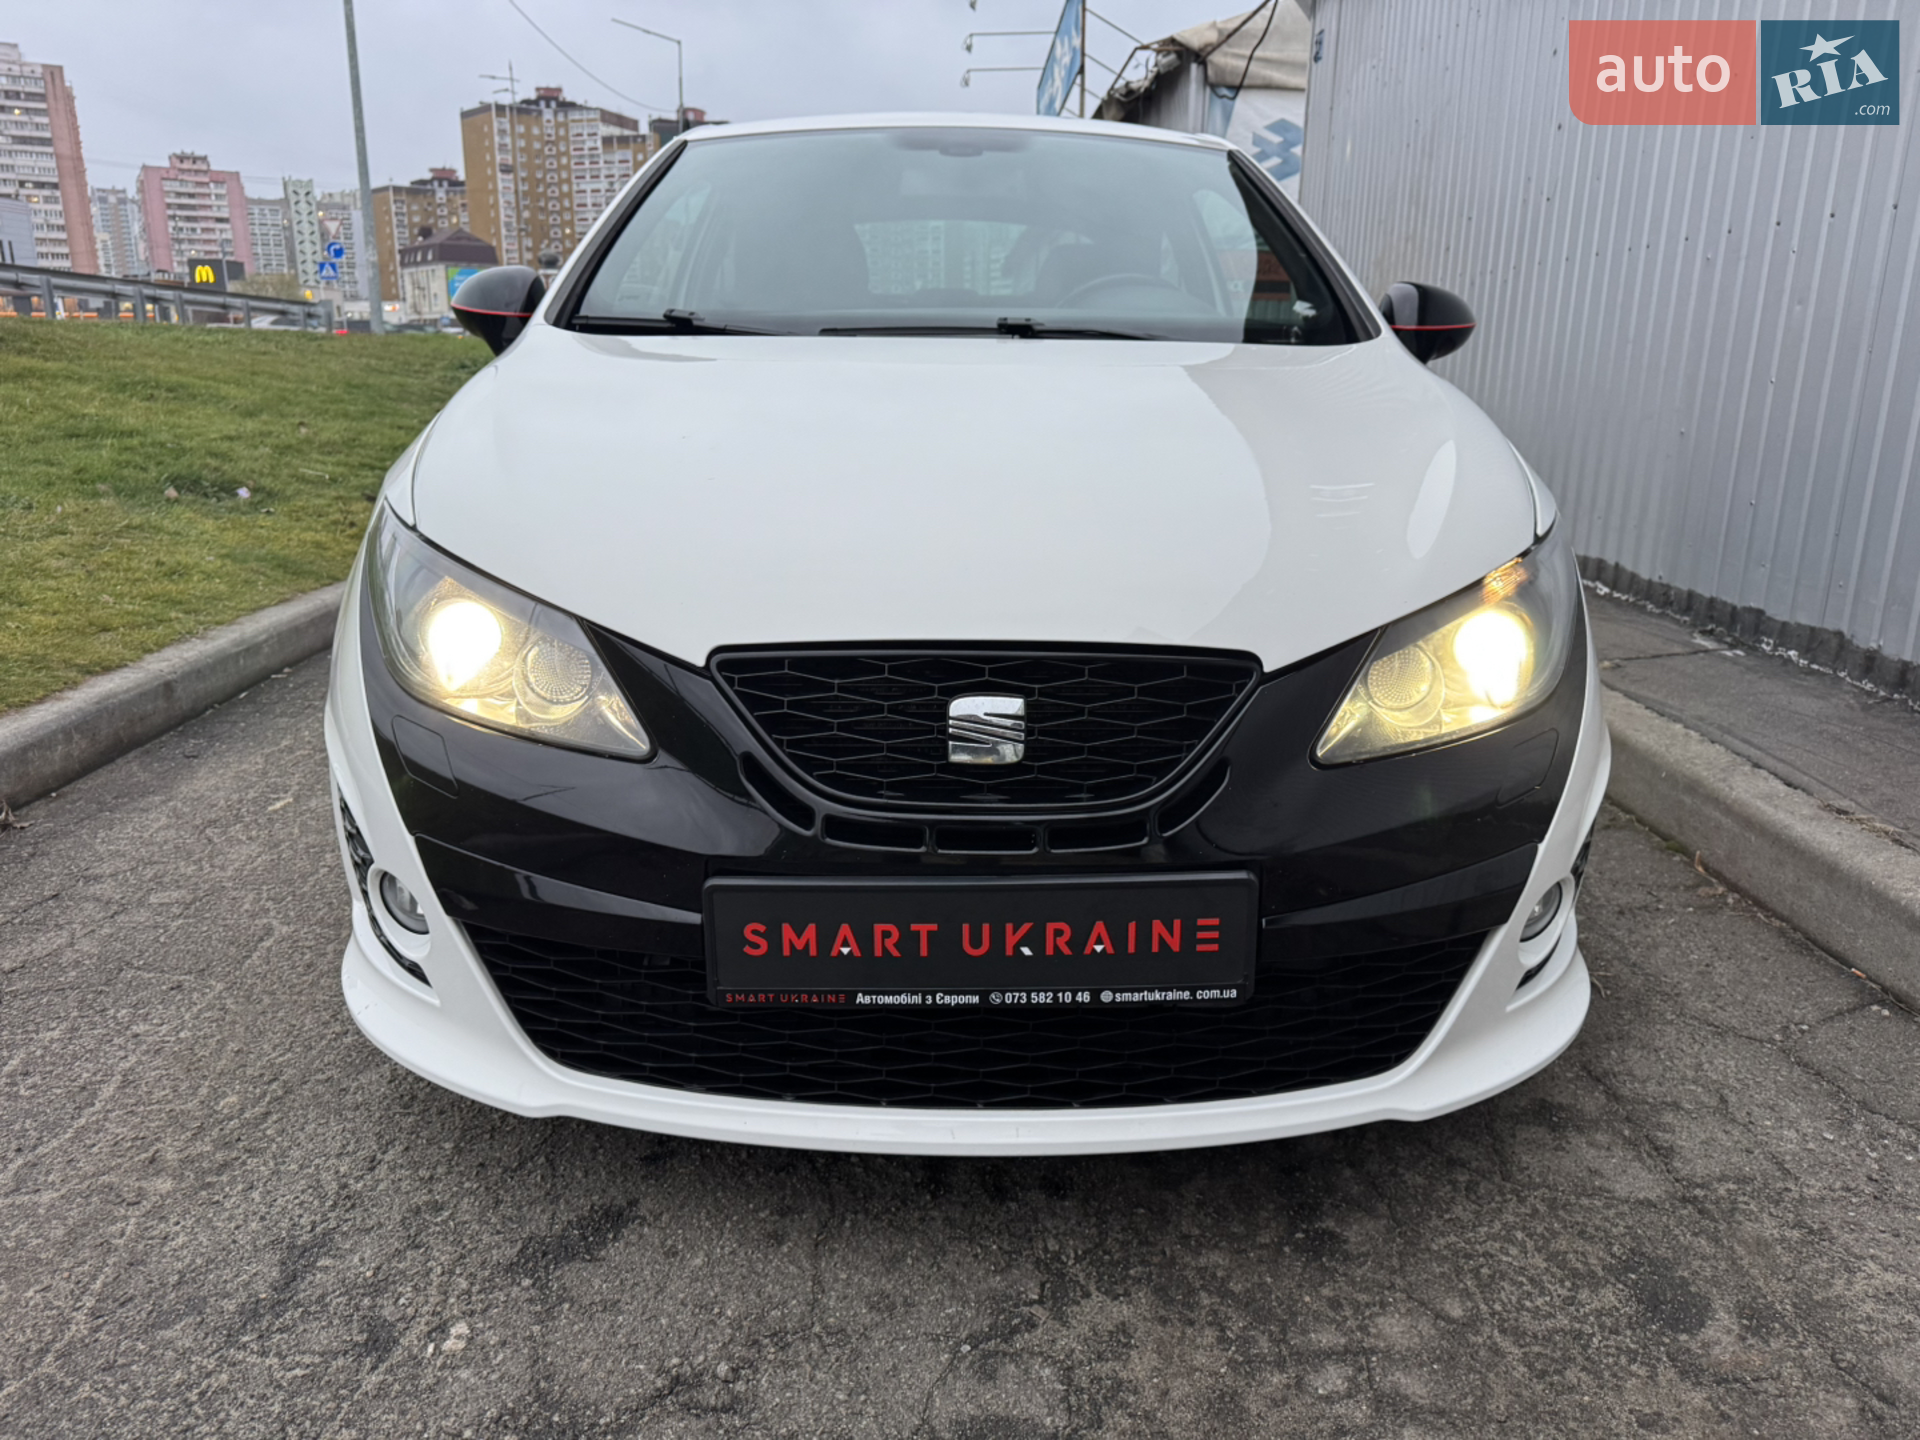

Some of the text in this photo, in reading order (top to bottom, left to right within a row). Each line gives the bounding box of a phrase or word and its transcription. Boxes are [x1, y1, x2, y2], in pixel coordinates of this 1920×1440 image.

[742, 918, 1220, 958] SMART UKRAINE
[725, 993, 846, 1004] SMART UKRAINE
[855, 992, 922, 1005] Автомобілі
[935, 992, 980, 1007] Європи
[1004, 991, 1091, 1004] 073 582 10 46
